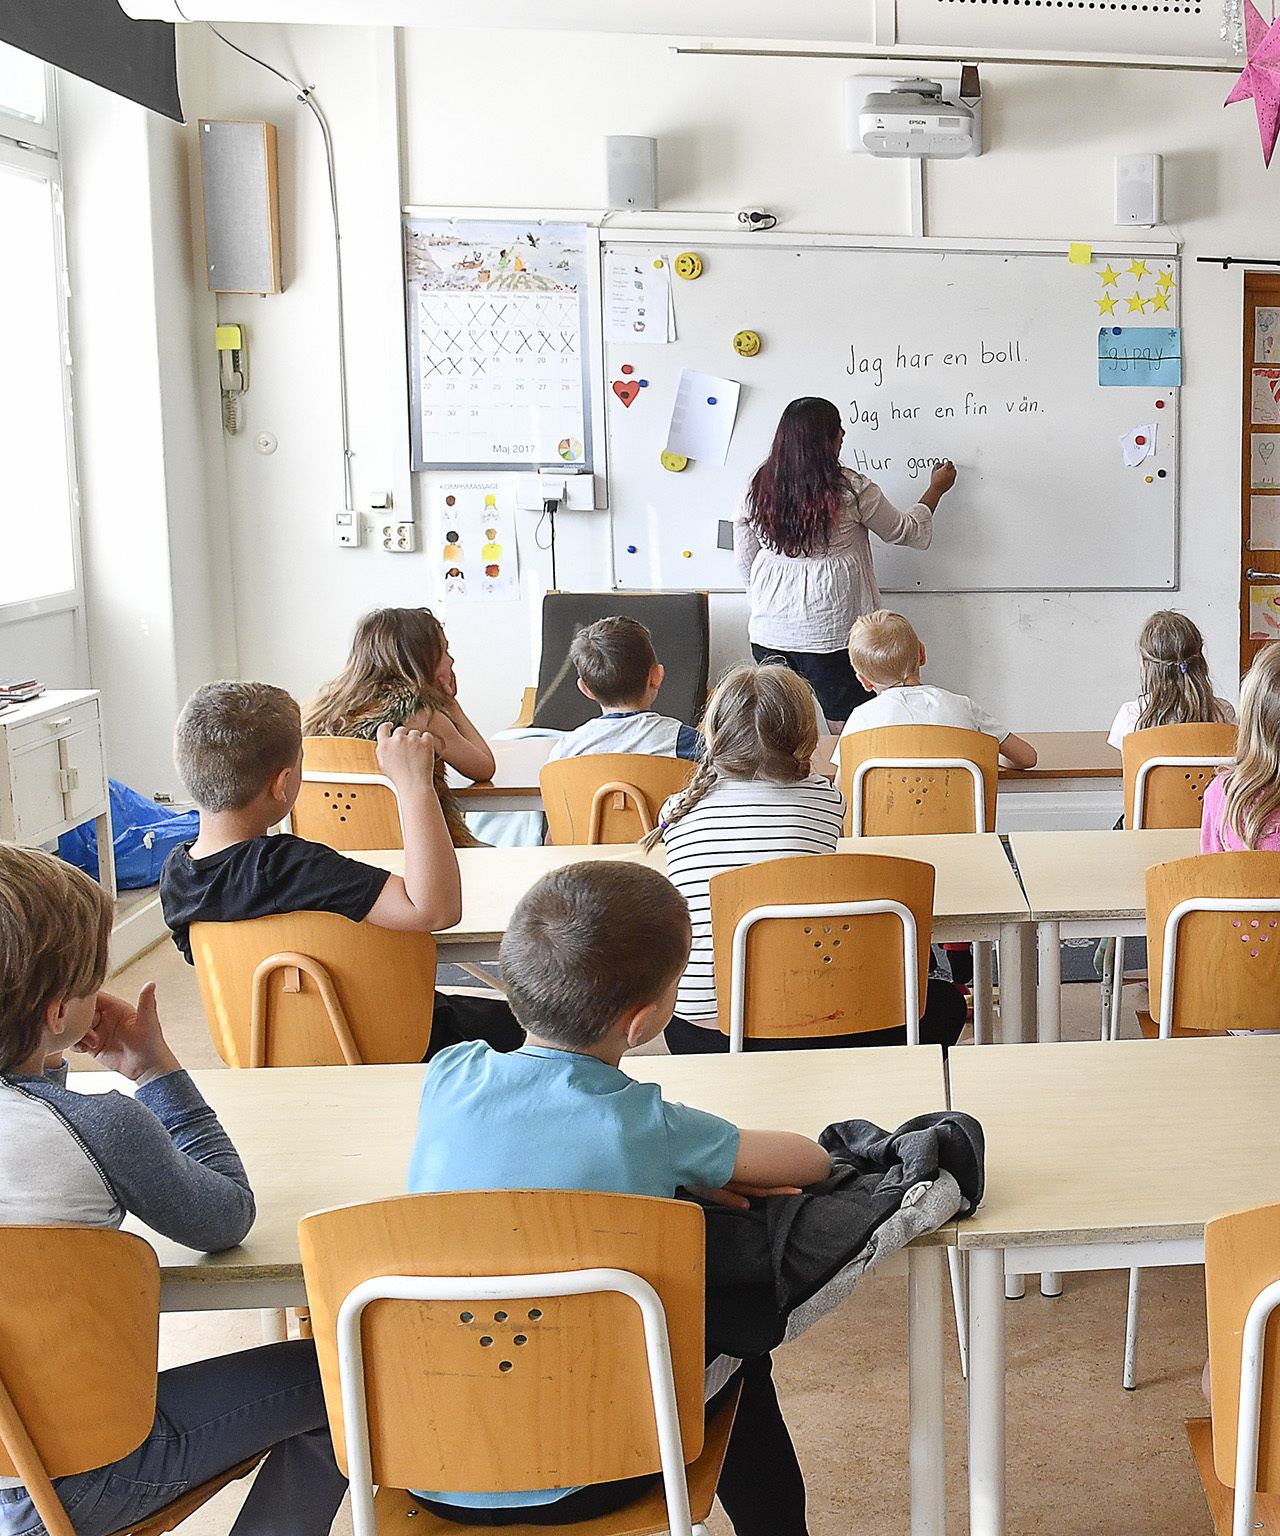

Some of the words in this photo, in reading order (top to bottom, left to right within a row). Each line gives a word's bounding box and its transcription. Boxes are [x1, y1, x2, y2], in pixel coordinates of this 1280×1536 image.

[846, 344, 883, 387] Jag
[896, 344, 934, 368] har
[943, 353, 968, 366] en
[981, 340, 1028, 364] boll.
[849, 400, 880, 431] Jag
[891, 401, 920, 419] har
[934, 406, 955, 419] en
[965, 392, 987, 415] fin
[1005, 396, 1045, 413] vän.
[492, 444, 510, 454] Maj
[512, 445, 535, 453] 2017
[853, 448, 892, 471] Hur
